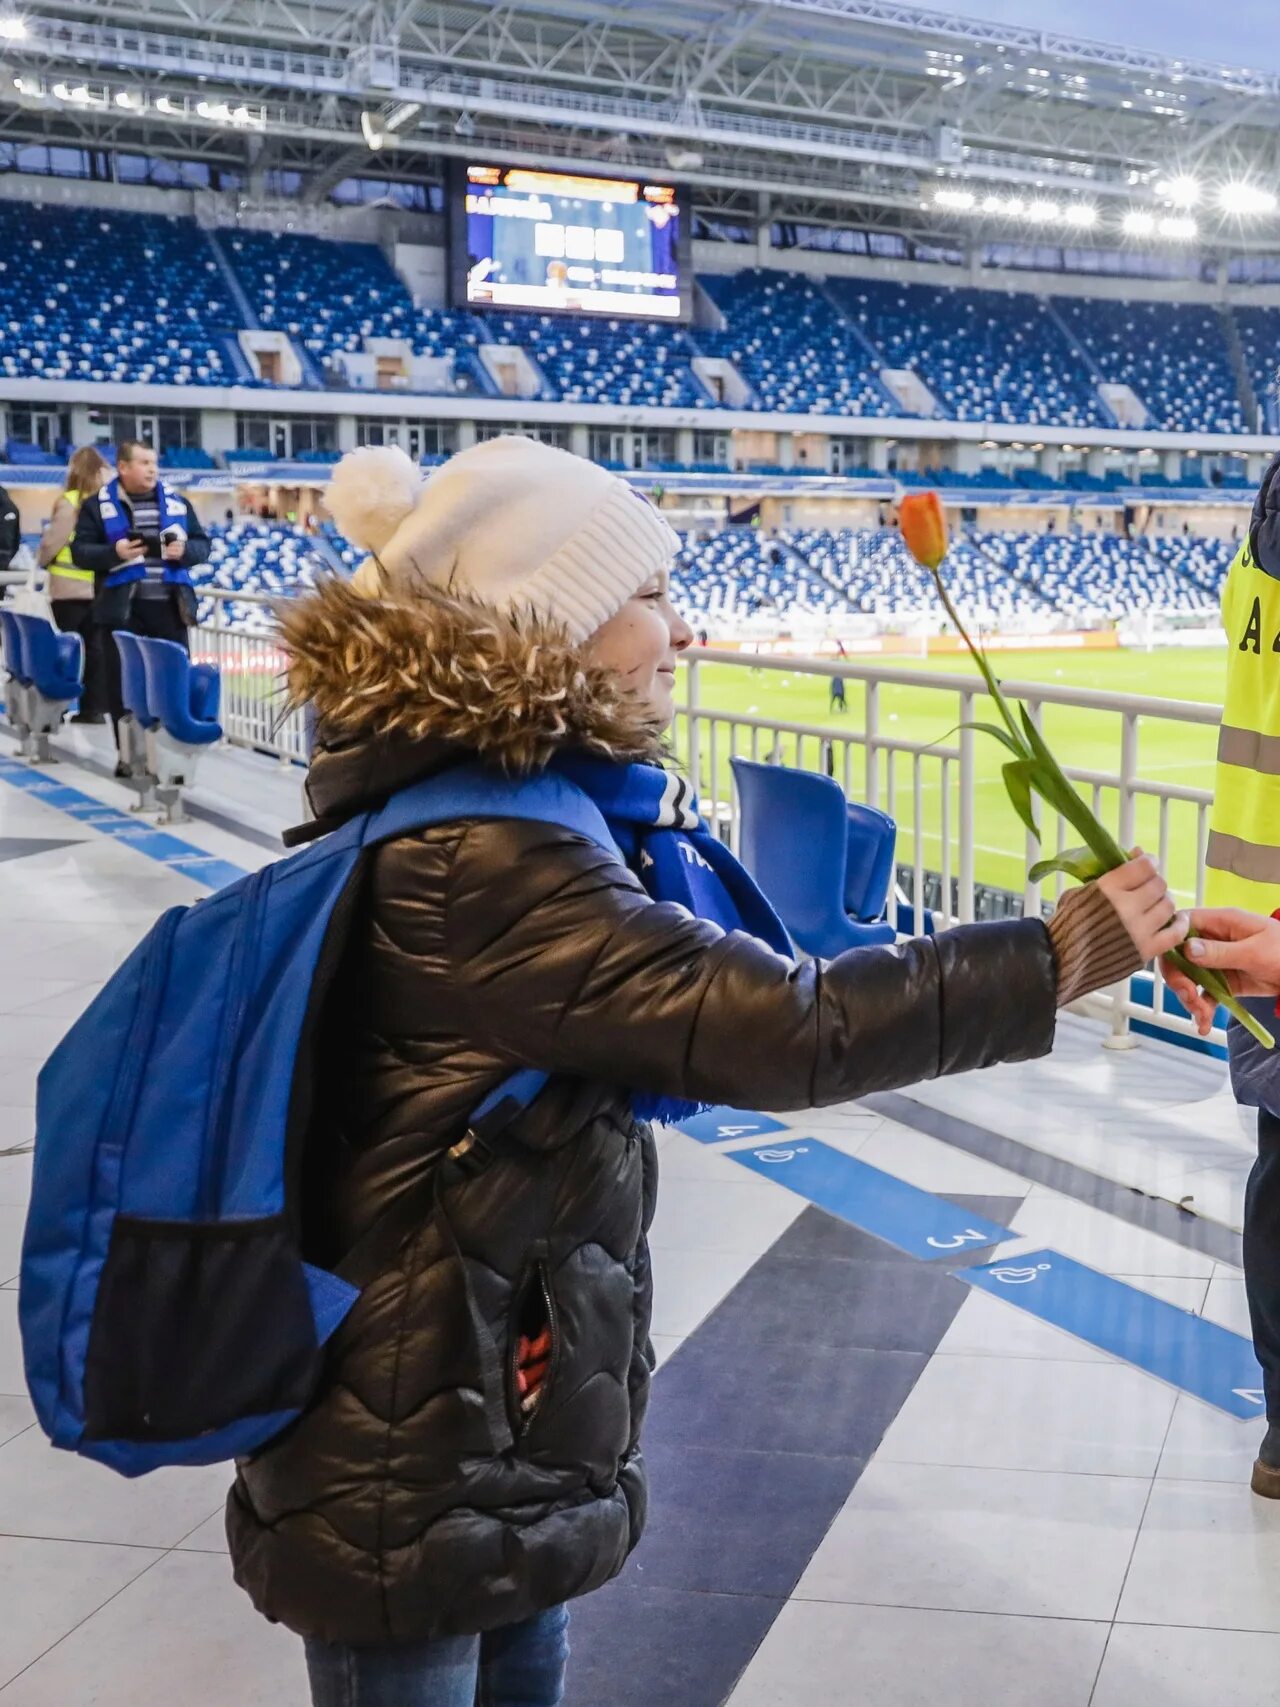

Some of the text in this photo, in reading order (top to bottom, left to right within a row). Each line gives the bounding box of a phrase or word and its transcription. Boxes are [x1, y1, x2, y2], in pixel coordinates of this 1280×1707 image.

[1239, 596, 1261, 655] A
[716, 1125, 760, 1137] 4
[926, 1228, 988, 1249] 3
